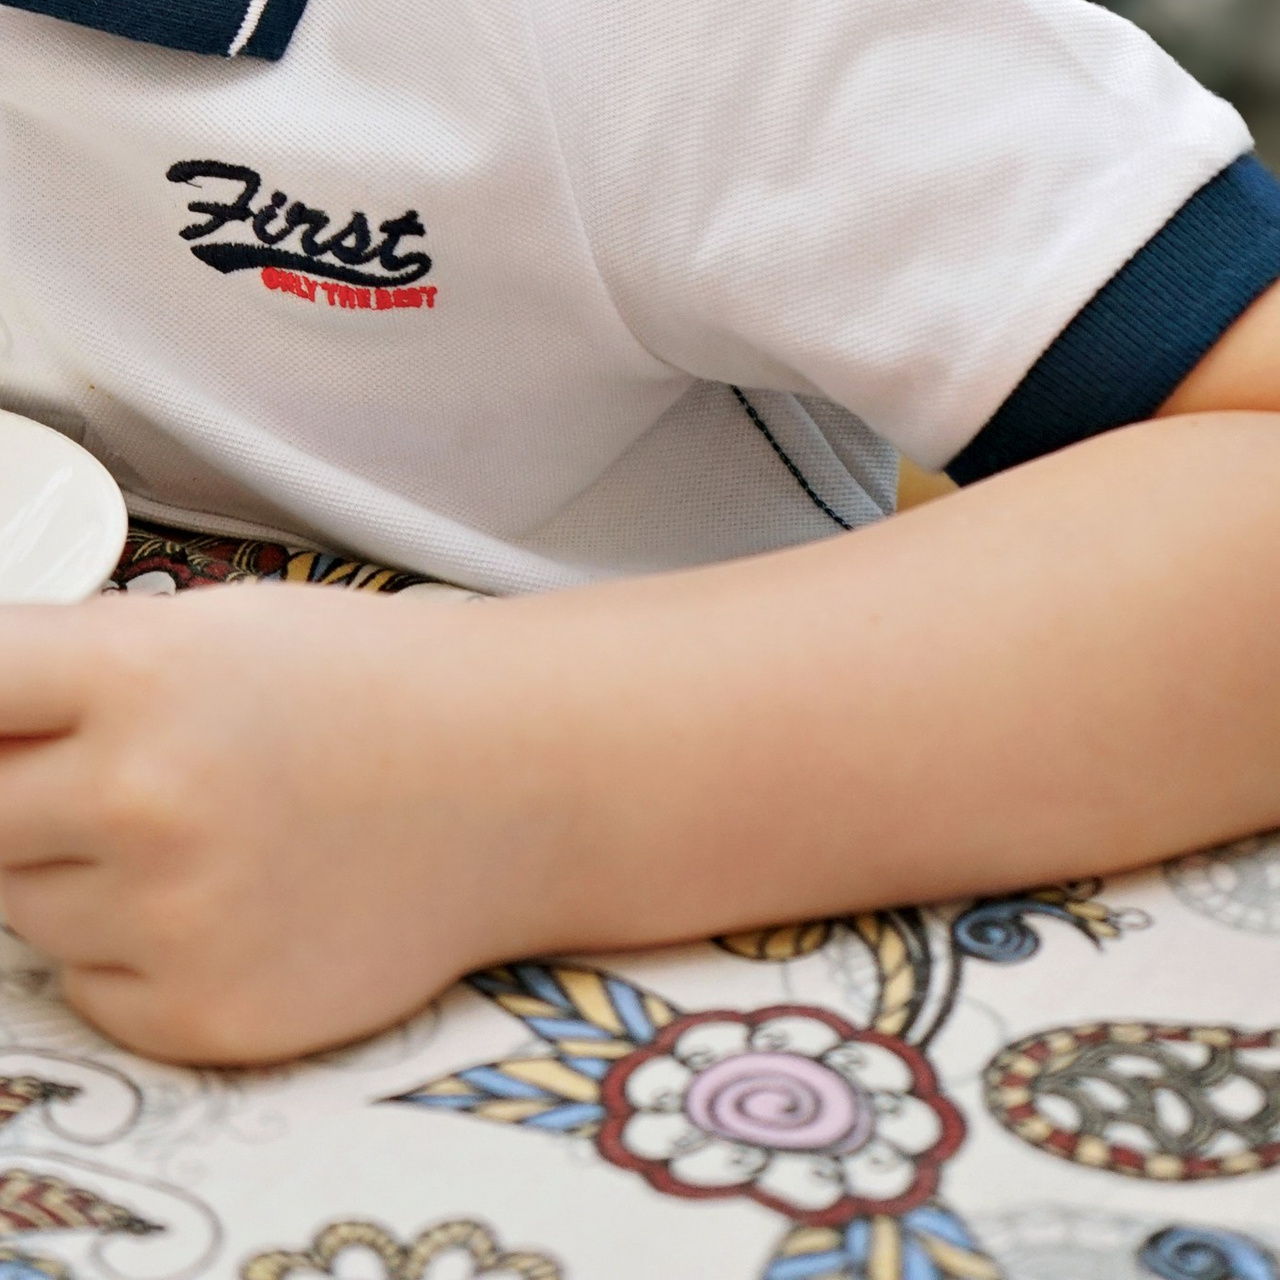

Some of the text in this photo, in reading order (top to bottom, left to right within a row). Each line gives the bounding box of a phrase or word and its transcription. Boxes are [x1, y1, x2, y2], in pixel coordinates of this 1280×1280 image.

[166, 160, 432, 274] First
[261, 267, 317, 302] ONLY
[319, 281, 371, 309] THE
